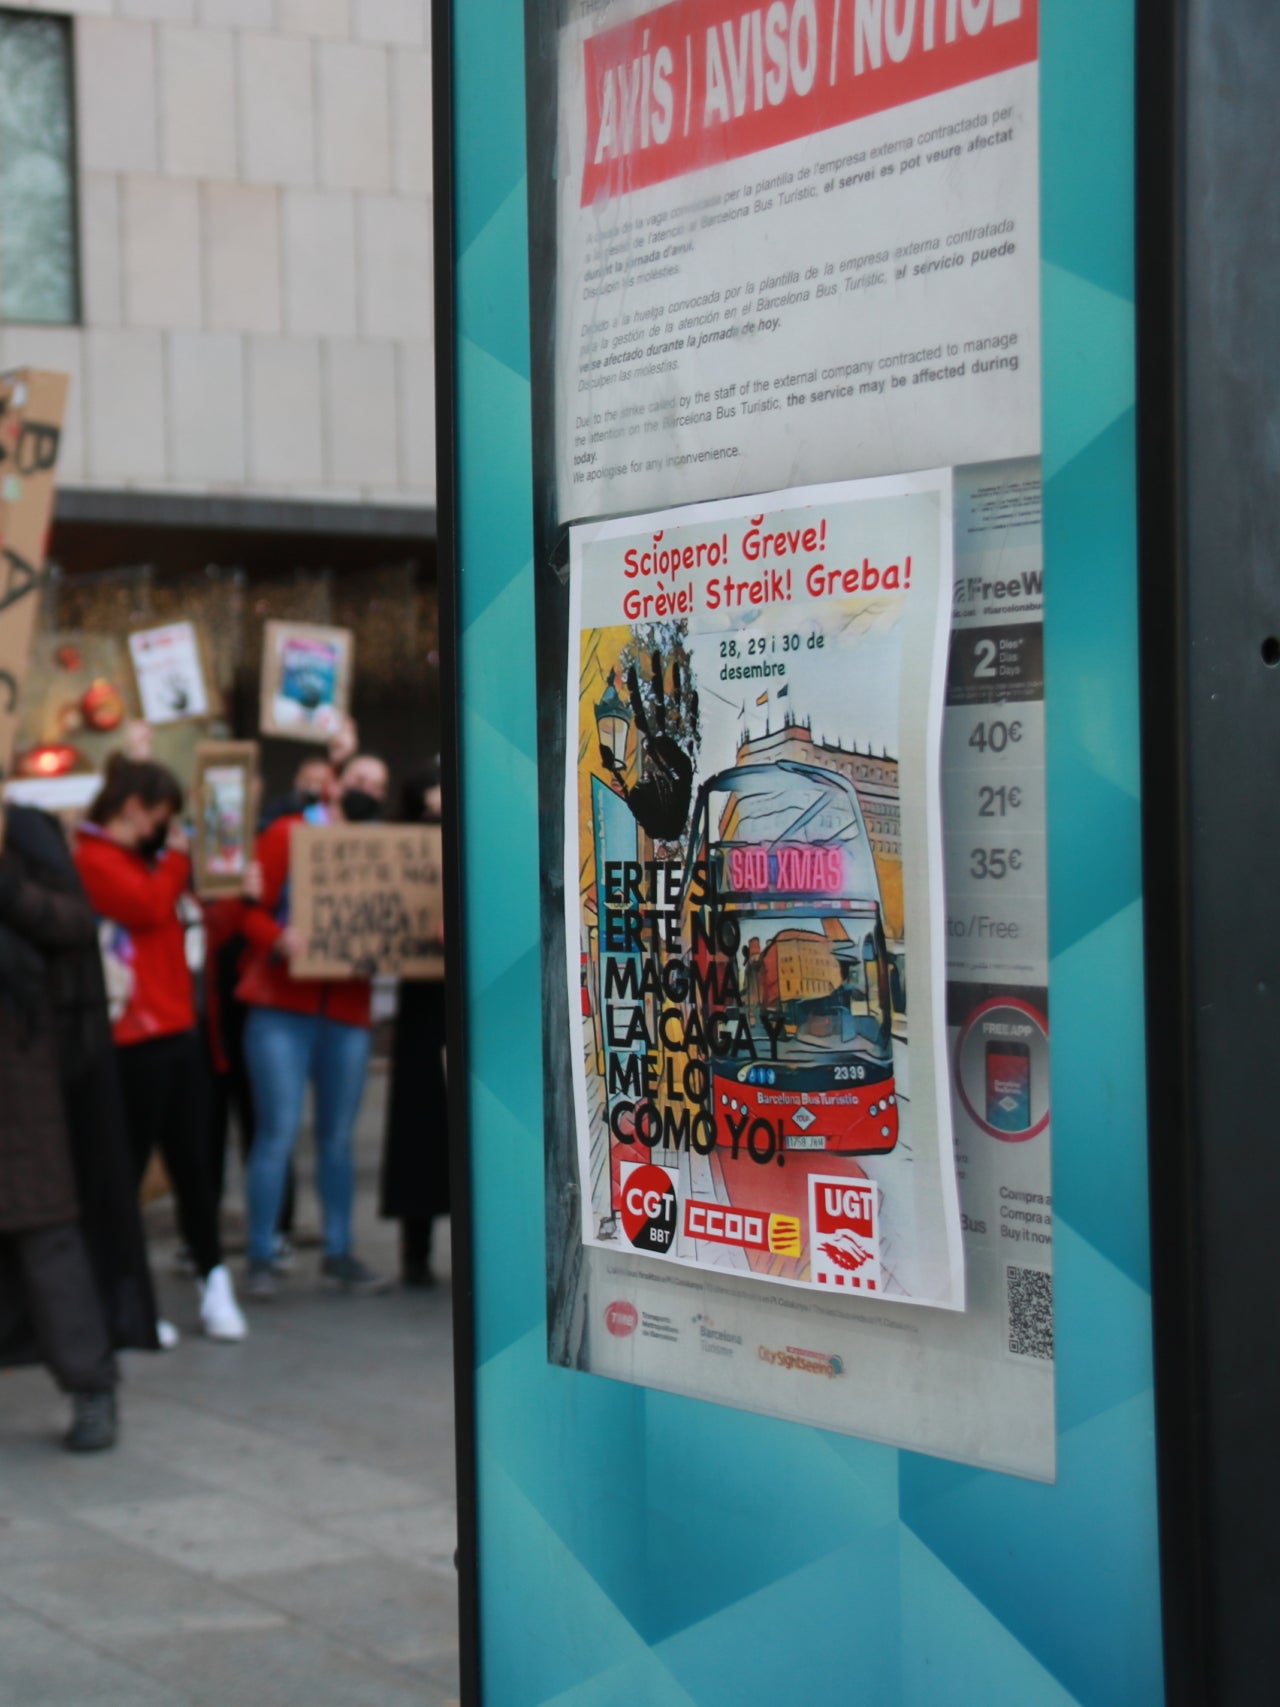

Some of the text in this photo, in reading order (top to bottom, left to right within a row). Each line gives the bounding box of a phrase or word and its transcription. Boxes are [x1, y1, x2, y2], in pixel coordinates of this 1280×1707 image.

[594, 28, 673, 164] AVÍS
[704, 0, 818, 129] AVISO
[723, 187, 742, 205] per
[743, 184, 754, 199] la
[754, 171, 795, 197] plantilla
[797, 165, 811, 182] de
[869, 136, 914, 160] externa
[916, 113, 989, 147] contractada
[991, 105, 1014, 129] per
[753, 197, 773, 215] Bus
[823, 178, 835, 194] el
[838, 167, 875, 190] servei
[880, 161, 895, 178] es
[899, 154, 922, 176] pot
[926, 142, 962, 165] veure
[967, 127, 1014, 153] afectat
[633, 217, 1016, 326] huelga convocada por la plantilla de la empresa externa contratada
[611, 327, 646, 350] gestión
[648, 323, 661, 338] de
[664, 321, 674, 334] la
[677, 309, 720, 331] atención
[723, 306, 738, 320] en
[742, 301, 753, 316] el
[756, 289, 810, 313] Barcelona
[815, 281, 838, 300] Bus
[895, 263, 908, 281] el
[912, 251, 965, 277] servicio
[969, 239, 1016, 267] puede
[602, 346, 644, 369] afectado
[645, 336, 685, 358] durante
[686, 332, 696, 348] la
[696, 323, 740, 349] jornada
[741, 320, 756, 335] de
[758, 315, 782, 334] hoy.
[604, 408, 618, 423] the
[679, 391, 692, 409] by
[694, 388, 711, 405] the
[714, 384, 738, 403] staff
[738, 381, 752, 397] of
[752, 378, 770, 394] the
[773, 368, 819, 390] external
[820, 359, 874, 381] company
[878, 343, 943, 370] contracted
[946, 342, 959, 358] to
[963, 331, 1019, 354] manage
[619, 367, 632, 381] las
[628, 421, 641, 436] on
[643, 418, 659, 434] the
[662, 408, 713, 432] Barcelona
[716, 403, 737, 421] Bus
[787, 392, 807, 409] the
[809, 383, 856, 404] service
[858, 378, 887, 397] may
[891, 373, 908, 390] be
[911, 361, 967, 386] affected
[970, 354, 1020, 375] during
[572, 444, 742, 485] We apologise for any inconvenience.
[573, 450, 599, 468] today.
[624, 518, 827, 583] Sciopero! Greve!
[622, 555, 913, 620] Grève! Streik! Greba!
[719, 631, 826, 661] 28, 29 i 30 de
[974, 639, 997, 678] 2
[719, 660, 787, 682] desembre
[968, 720, 1023, 754] 40€
[978, 785, 1023, 818] 21€
[604, 861, 682, 905] ERTE
[731, 848, 843, 893] SAD XMAS
[970, 848, 1023, 881] 35€
[605, 909, 682, 955] ERTE
[604, 957, 743, 1005] MAGMA
[604, 1003, 786, 1061] LA CAGA Y
[982, 1021, 1034, 1037] FREE APP
[608, 1052, 710, 1105] ME LO
[833, 1065, 866, 1081] 2339
[610, 1100, 786, 1168] COMO YO!
[626, 1188, 675, 1222] CGT
[824, 1187, 873, 1220] UGT
[999, 1185, 1045, 1206] Compra
[1000, 1205, 1043, 1225] Compra
[649, 1227, 671, 1245] BBT
[688, 1206, 764, 1244] CCOO
[1000, 1224, 1021, 1243] Buy
[1022, 1226, 1030, 1240] it
